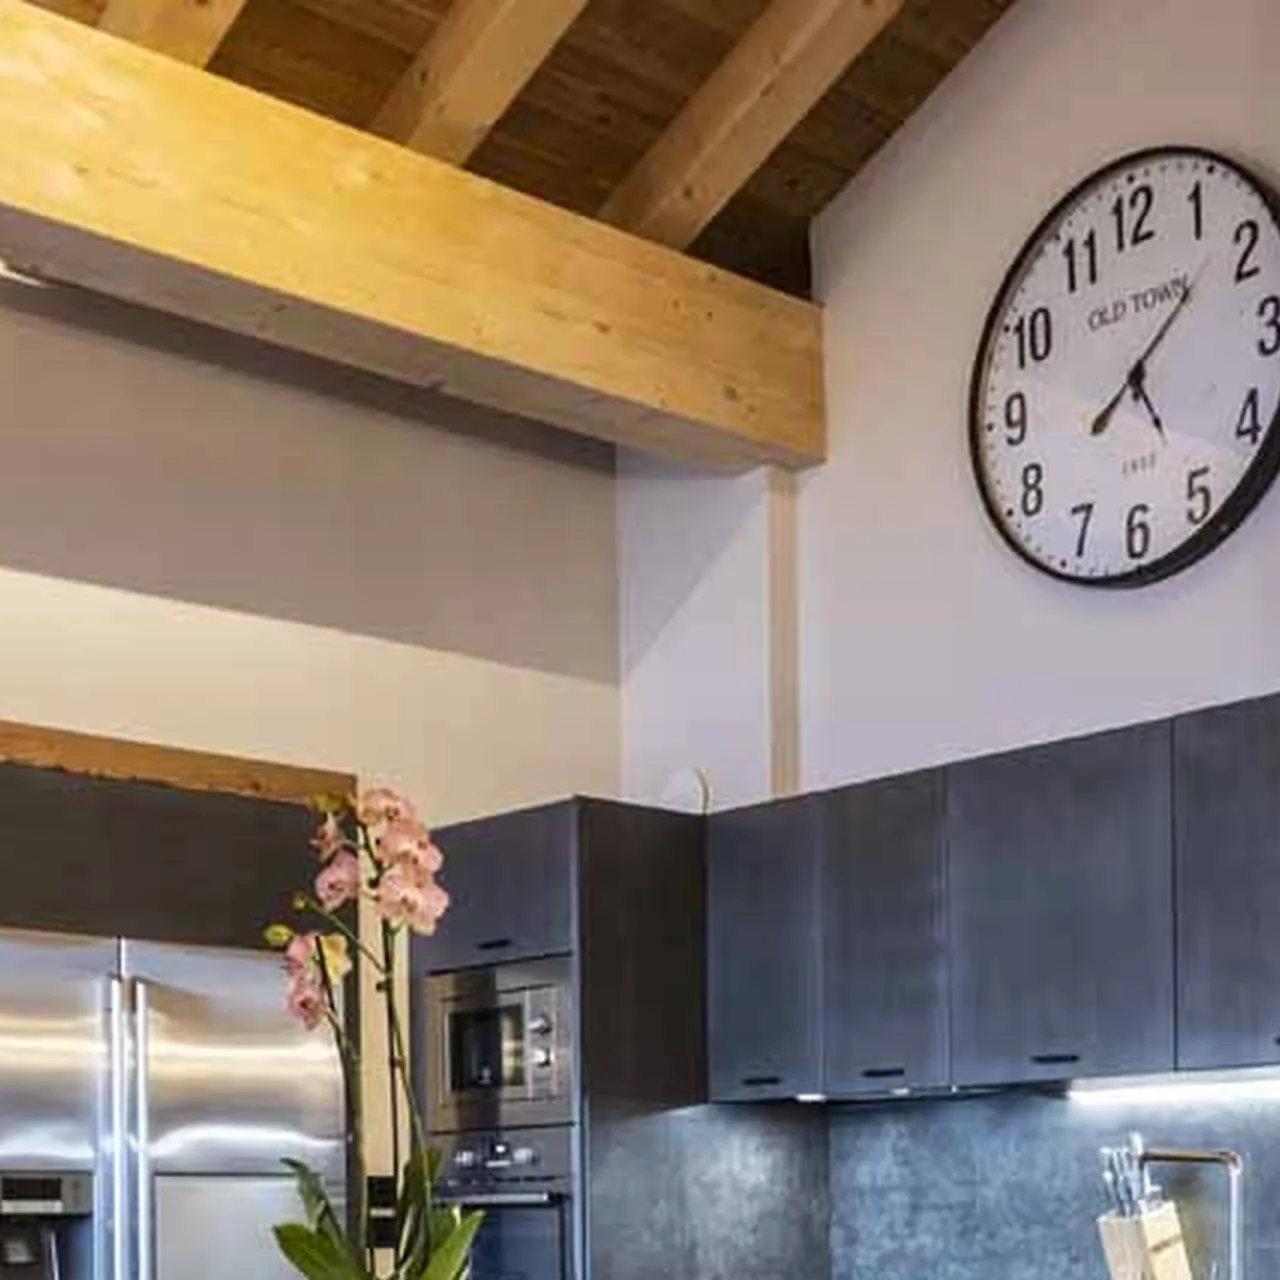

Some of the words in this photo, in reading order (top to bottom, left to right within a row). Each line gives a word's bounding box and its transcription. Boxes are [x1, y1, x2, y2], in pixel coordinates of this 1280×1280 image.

[1110, 185, 1156, 252] 12
[1188, 181, 1203, 240] 1
[1062, 229, 1097, 293] 11
[1233, 220, 1260, 282] 2
[1087, 299, 1127, 333] OLD
[1129, 273, 1193, 314] TOWN
[1013, 306, 1053, 369] 10
[1005, 392, 1027, 446] 9
[1236, 387, 1262, 446] 4
[1022, 463, 1043, 516] 8
[1187, 466, 1212, 525] 5
[1071, 503, 1094, 558] 7
[1126, 504, 1150, 559] 6
